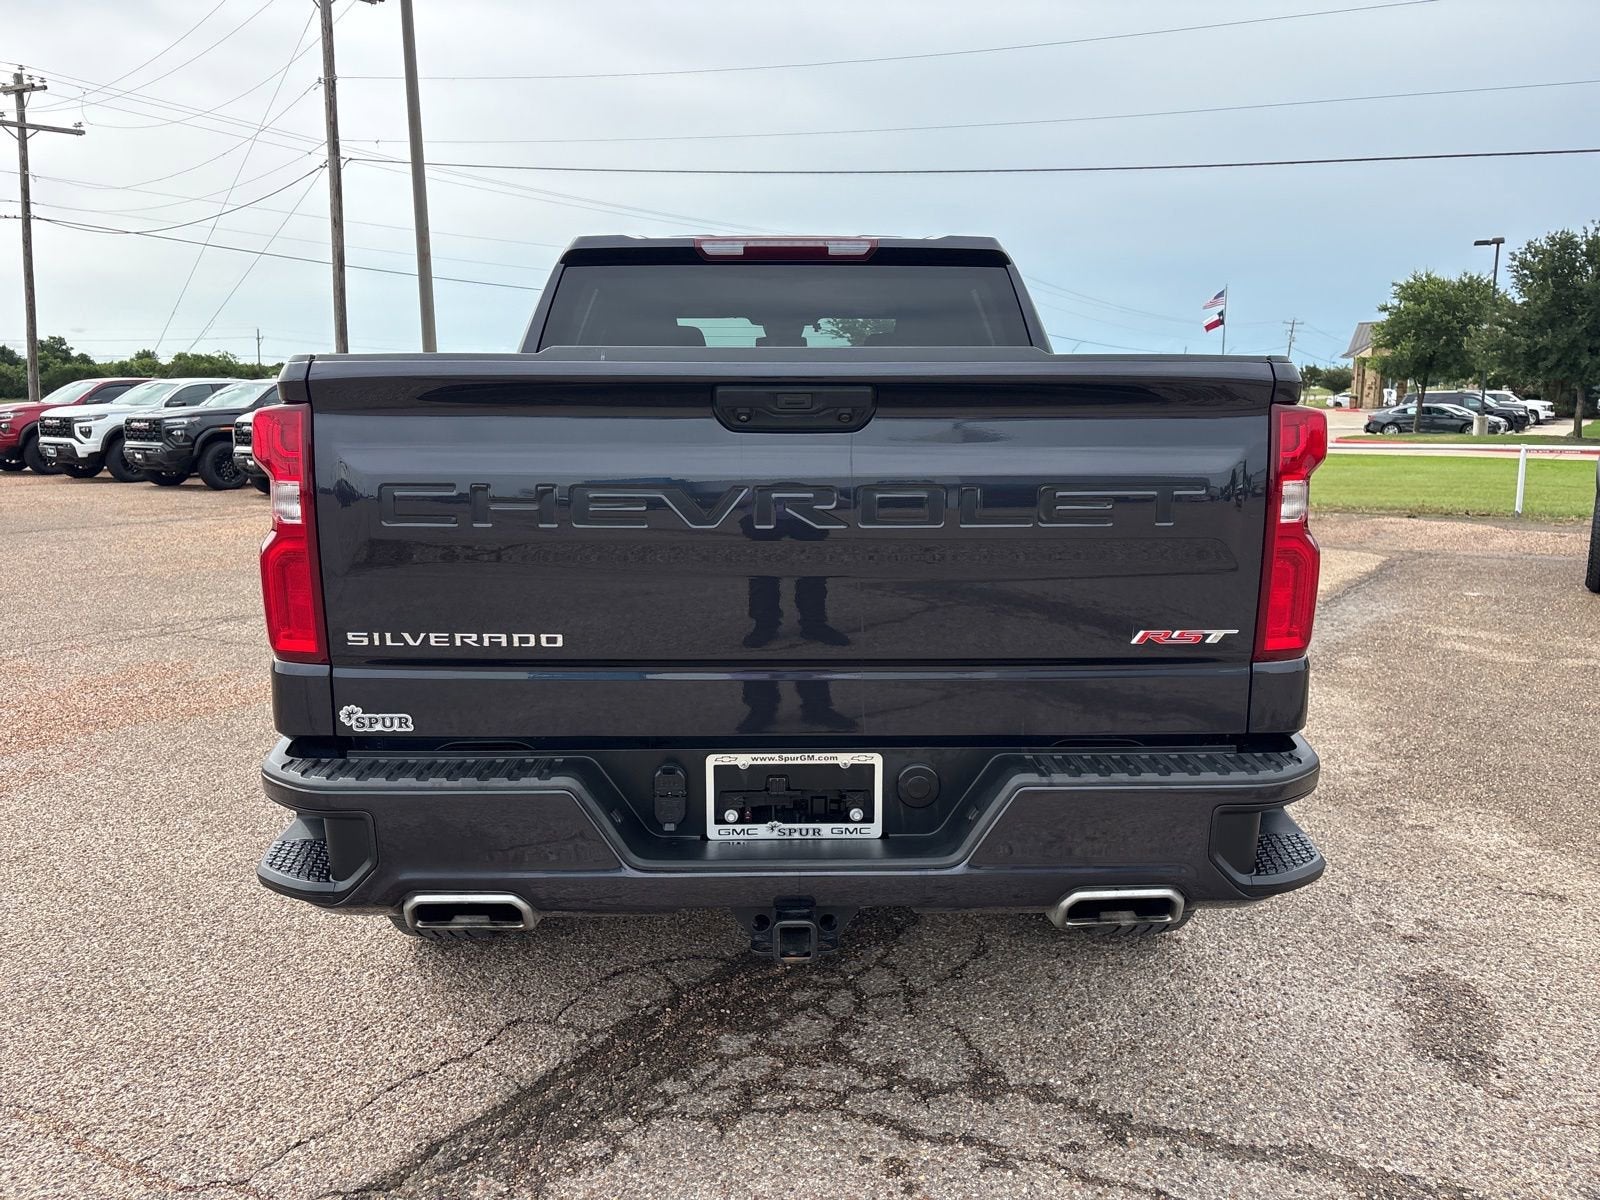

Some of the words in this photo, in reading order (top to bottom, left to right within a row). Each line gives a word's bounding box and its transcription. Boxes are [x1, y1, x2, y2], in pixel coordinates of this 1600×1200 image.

[378, 482, 1208, 529] CHEVROLET
[346, 631, 564, 648] SILVERADO
[1130, 629, 1239, 644] RST
[355, 716, 411, 729] SPUR
[751, 754, 838, 762] www.SpurGM.com
[718, 828, 759, 836] GMC
[777, 827, 823, 837] SPUR
[830, 827, 871, 835] GMC
